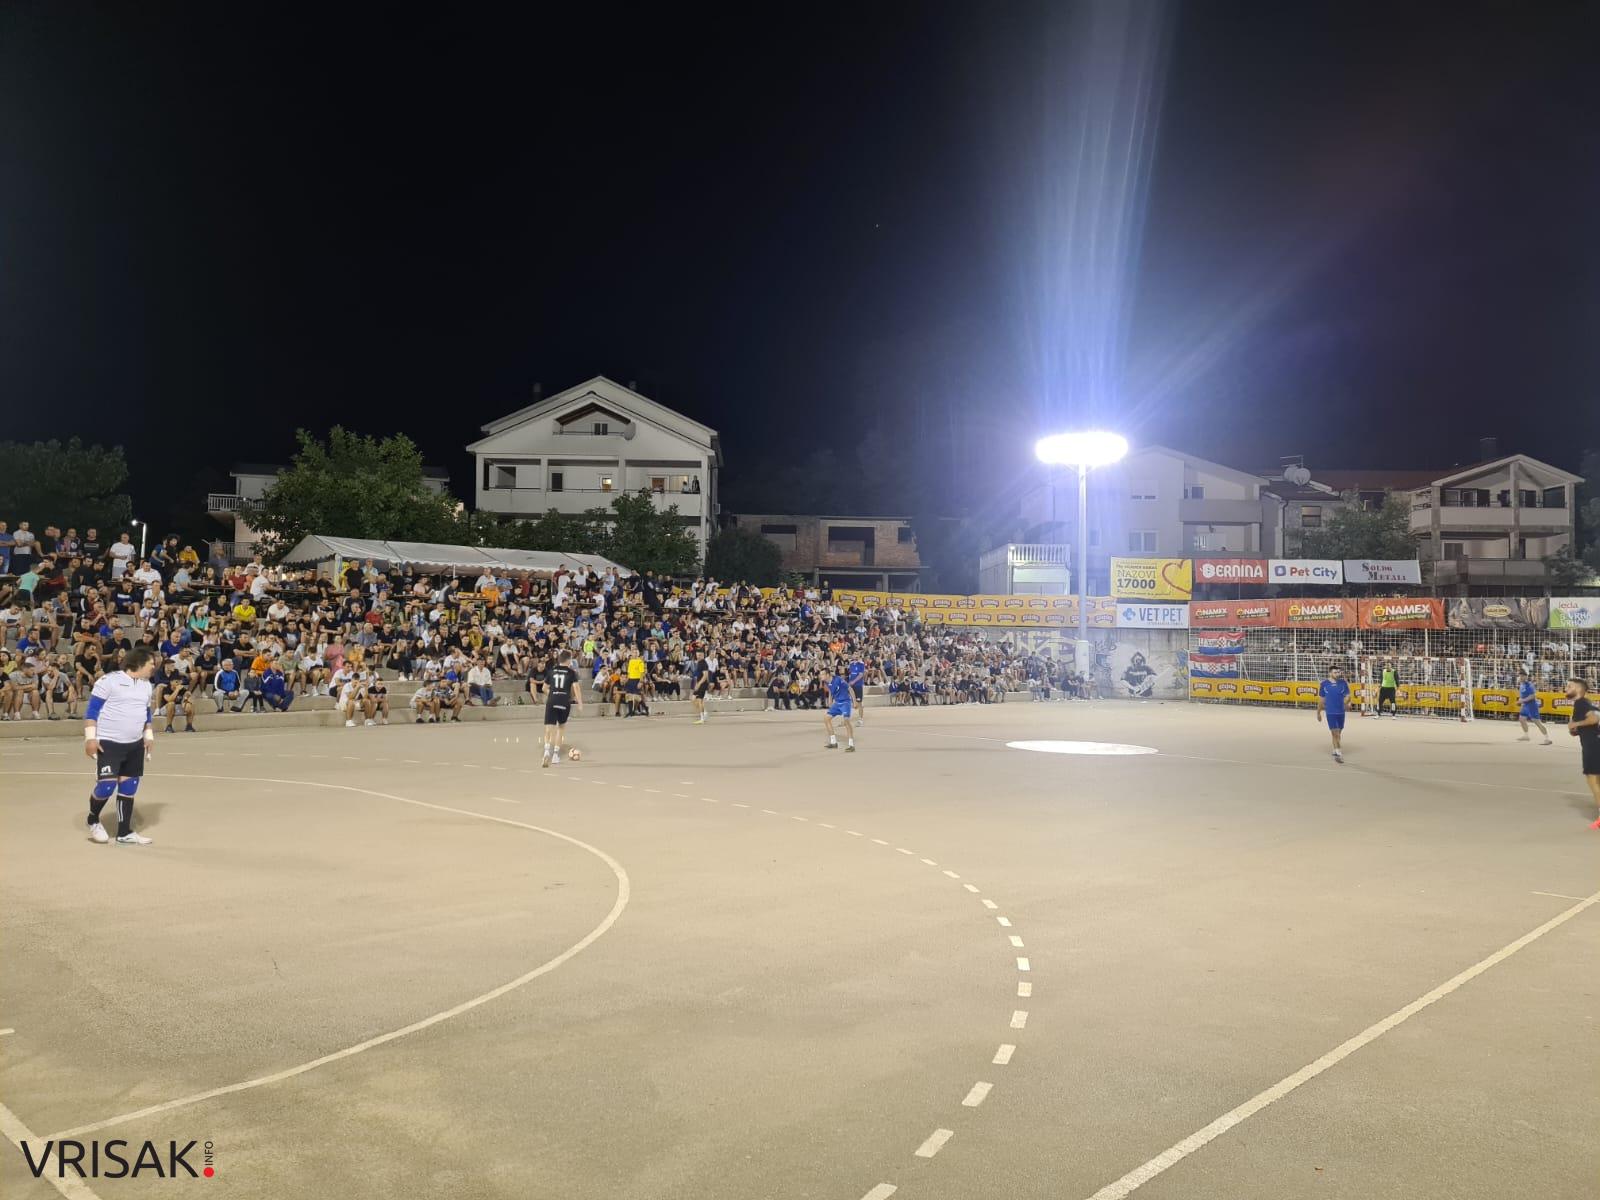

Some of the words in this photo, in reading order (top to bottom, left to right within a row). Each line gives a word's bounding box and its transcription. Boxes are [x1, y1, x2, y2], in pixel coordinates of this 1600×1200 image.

[1117, 570, 1156, 579] NAZOVI
[1202, 563, 1264, 578] BERNINA
[1290, 567, 1310, 577] Pet
[1312, 567, 1337, 580] City
[1117, 579, 1156, 590] 17000
[1139, 607, 1161, 622] VET
[1162, 608, 1183, 622] PET
[1243, 607, 1270, 615] NAMEX
[1301, 604, 1342, 616] NAMEX
[1385, 604, 1430, 616] NAMEX
[553, 673, 565, 689] 11
